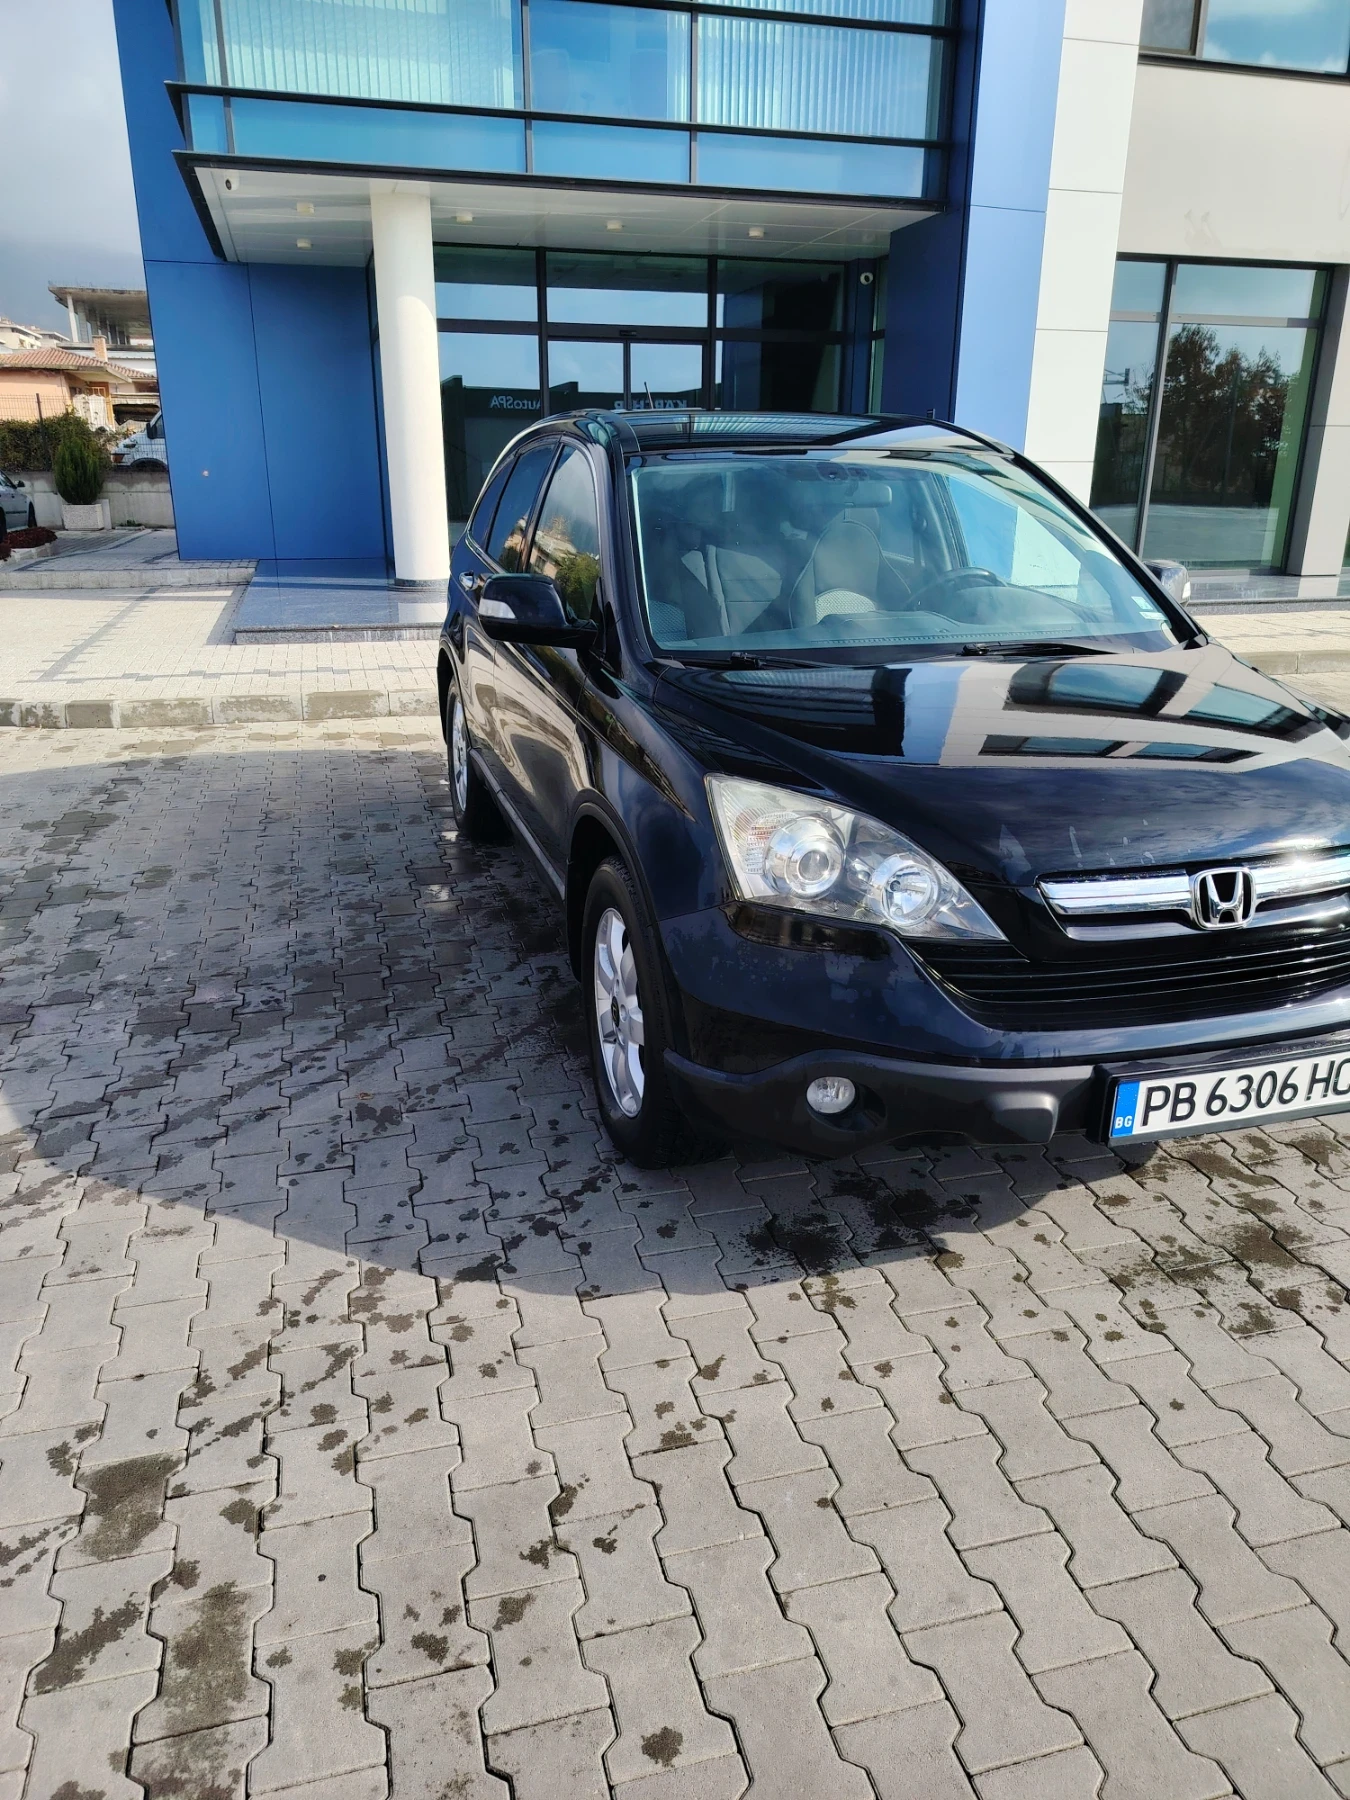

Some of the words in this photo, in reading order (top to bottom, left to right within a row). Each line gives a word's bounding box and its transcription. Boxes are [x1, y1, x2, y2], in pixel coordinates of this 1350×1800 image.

[1141, 1082, 1197, 1127] PB
[1206, 1066, 1299, 1116] 6306
[1115, 1116, 1133, 1129] BG
